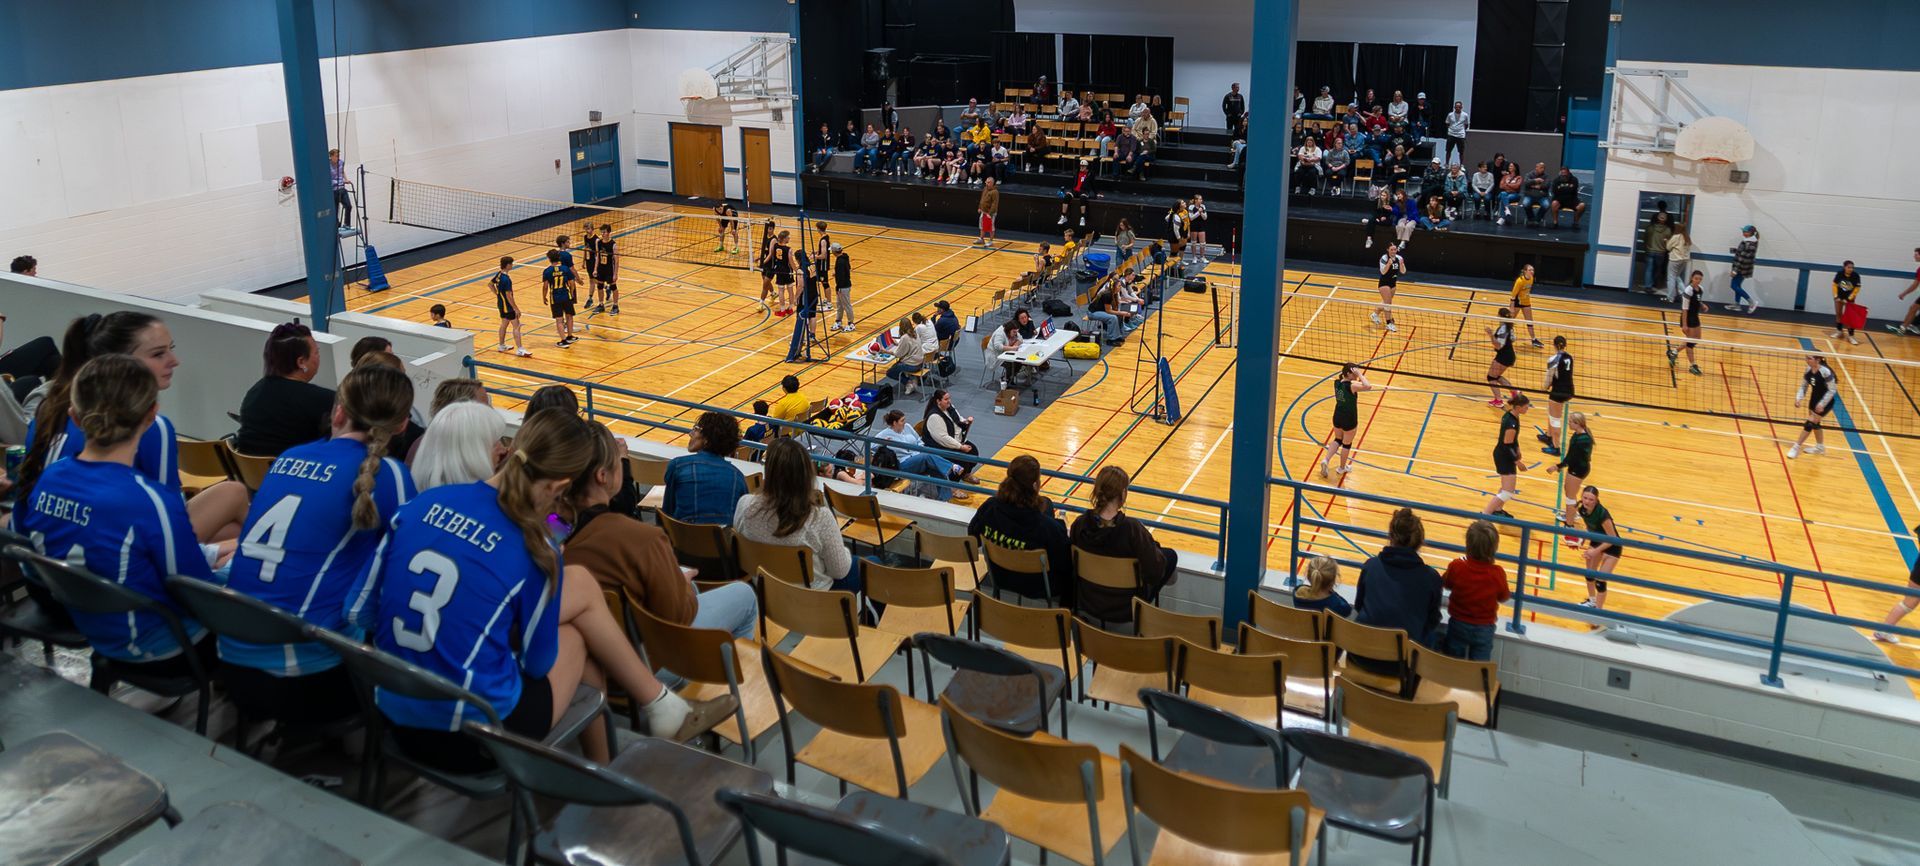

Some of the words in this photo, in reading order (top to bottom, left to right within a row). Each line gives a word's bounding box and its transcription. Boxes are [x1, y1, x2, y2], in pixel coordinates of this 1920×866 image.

[553, 276, 564, 289] 11
[1564, 358, 1571, 371] 7
[268, 457, 337, 483] REBELS
[34, 491, 92, 527] REBELS
[240, 494, 302, 583] 4
[422, 503, 502, 553] REBELS
[392, 549, 459, 652] 3
